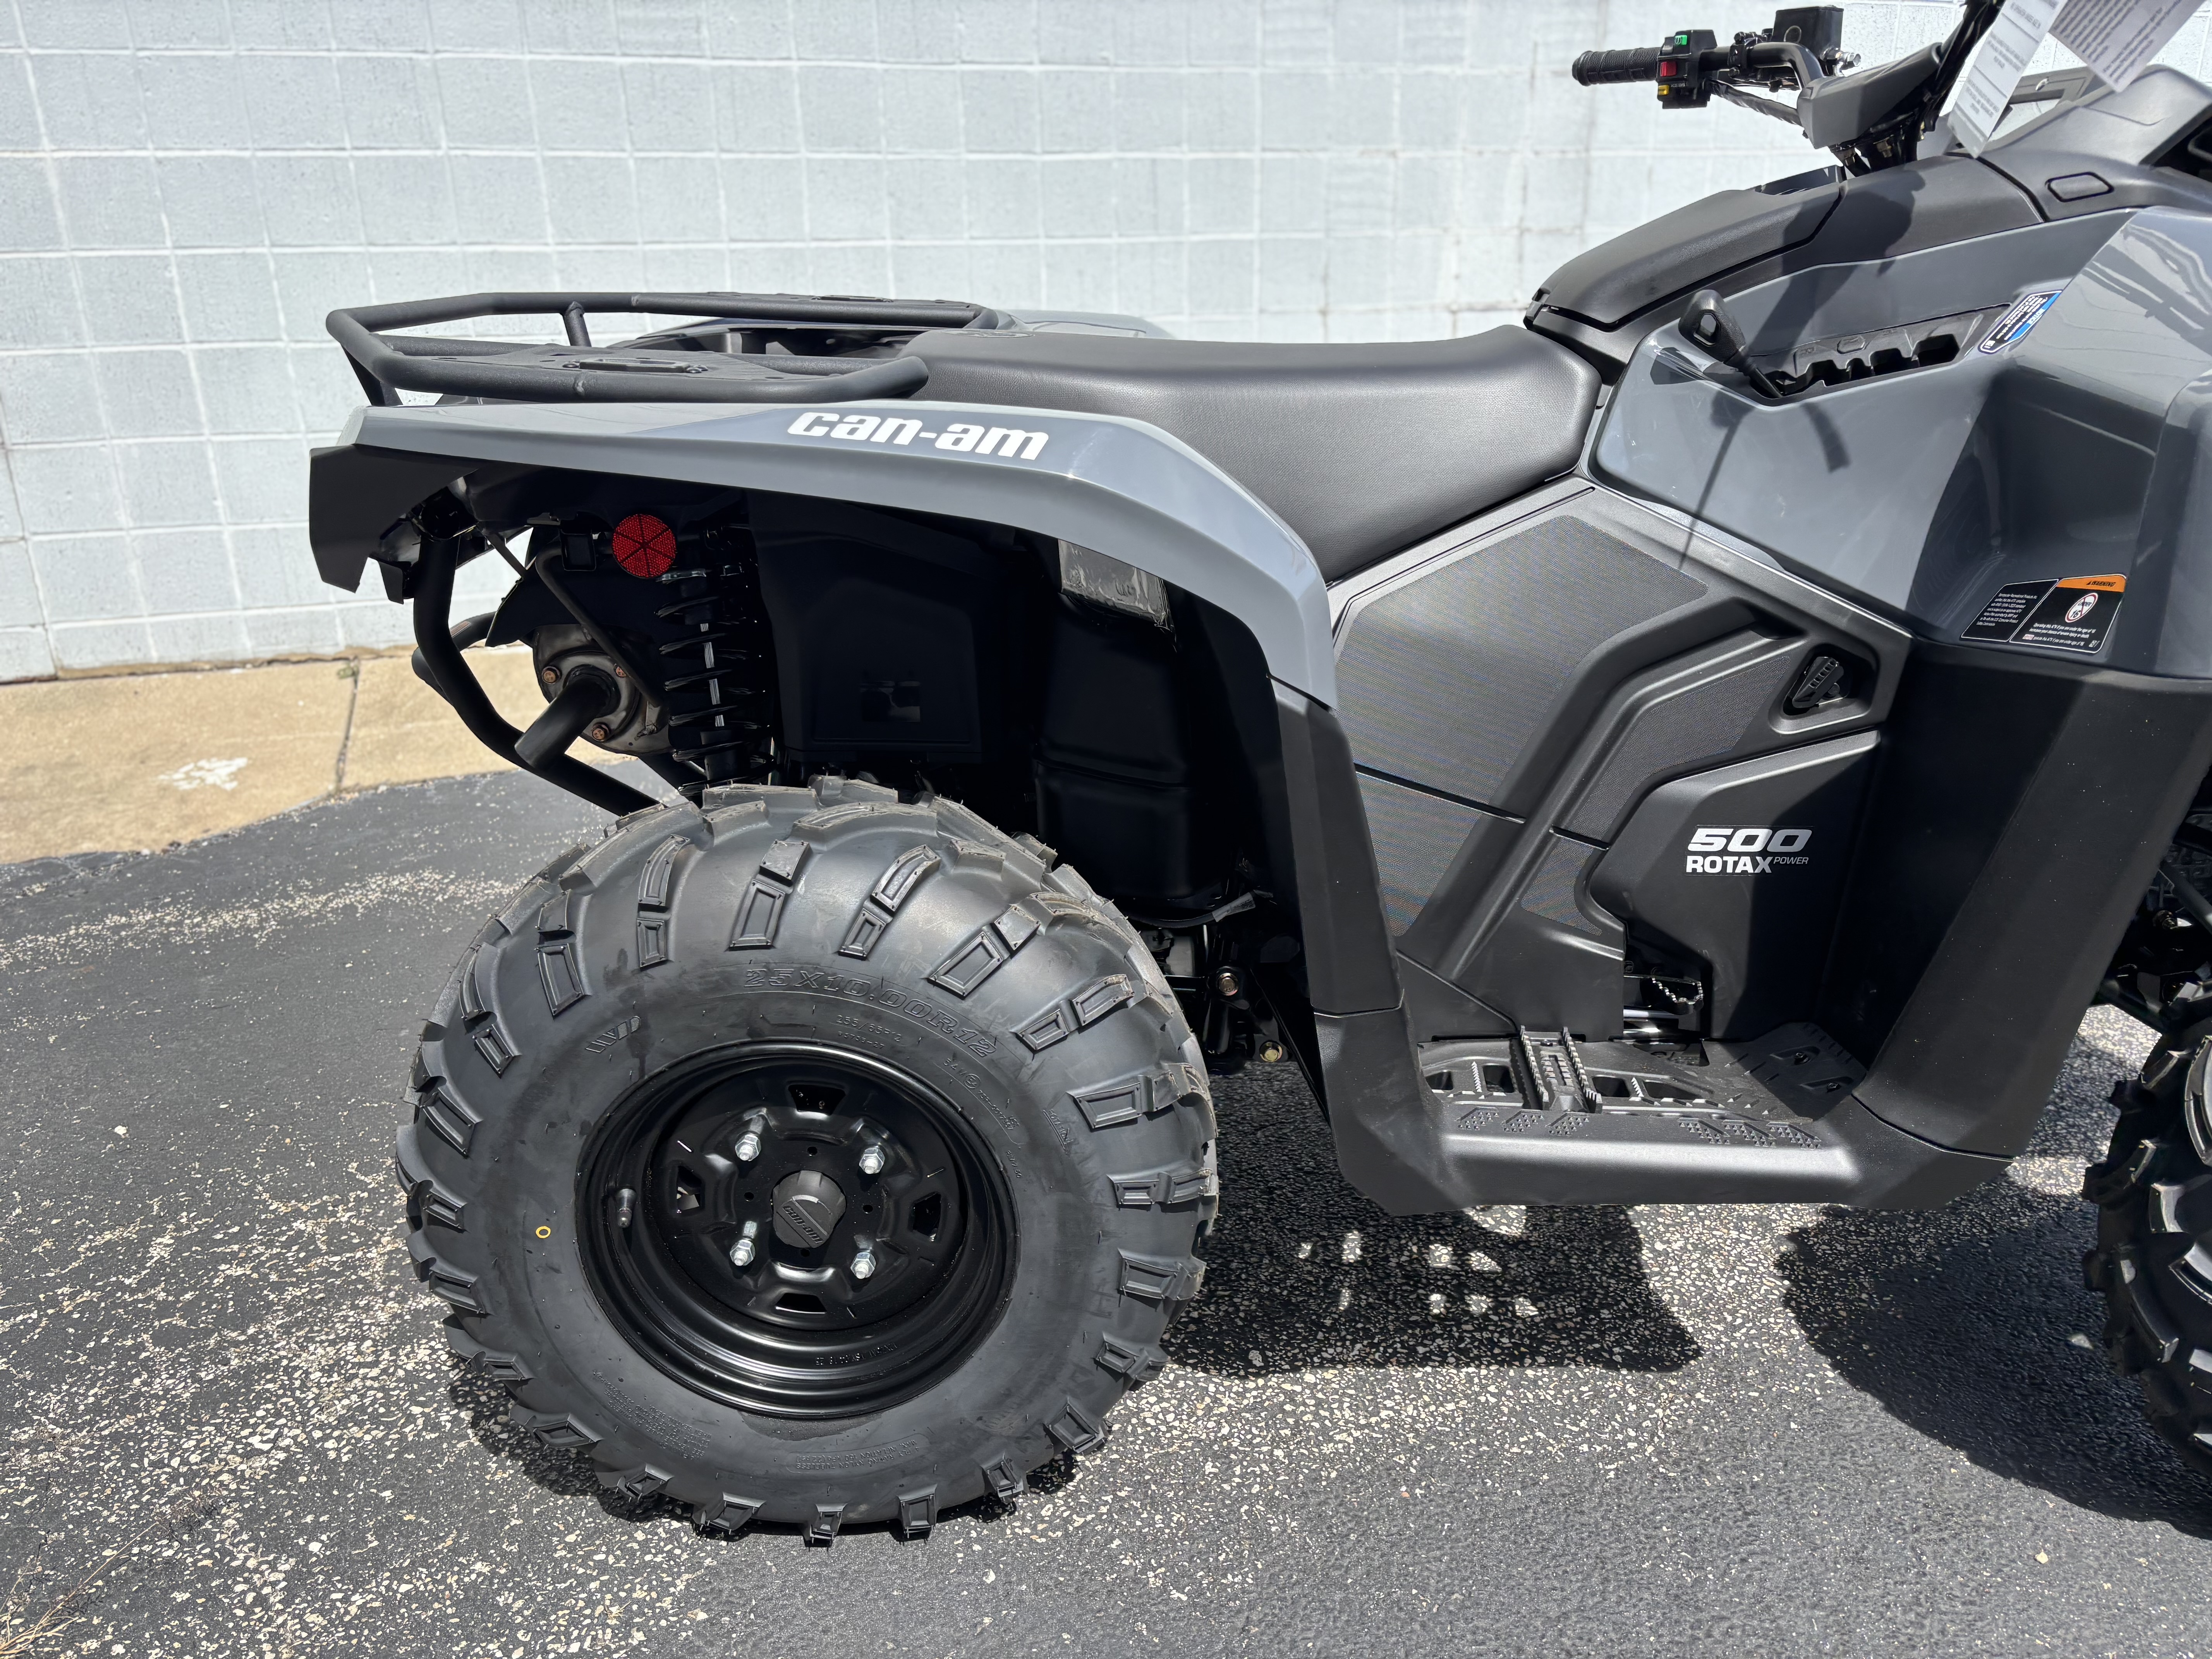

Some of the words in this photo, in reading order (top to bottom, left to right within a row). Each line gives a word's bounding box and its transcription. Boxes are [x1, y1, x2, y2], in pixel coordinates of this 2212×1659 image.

[787, 411, 1049, 461] can-am
[2070, 610, 2081, 618] 16
[1687, 828, 1812, 852] 500
[1686, 855, 1773, 874] ROTAX
[1773, 856, 1809, 865] POWER
[782, 1205, 824, 1243] can-am
[635, 1405, 659, 1421] BEYOND
[646, 1425, 663, 1435] LABEL
[667, 1416, 692, 1431] SEATING
[860, 1446, 897, 1458] INFLATION
[868, 1454, 894, 1464] RATING
[839, 1459, 864, 1468] NYLON
